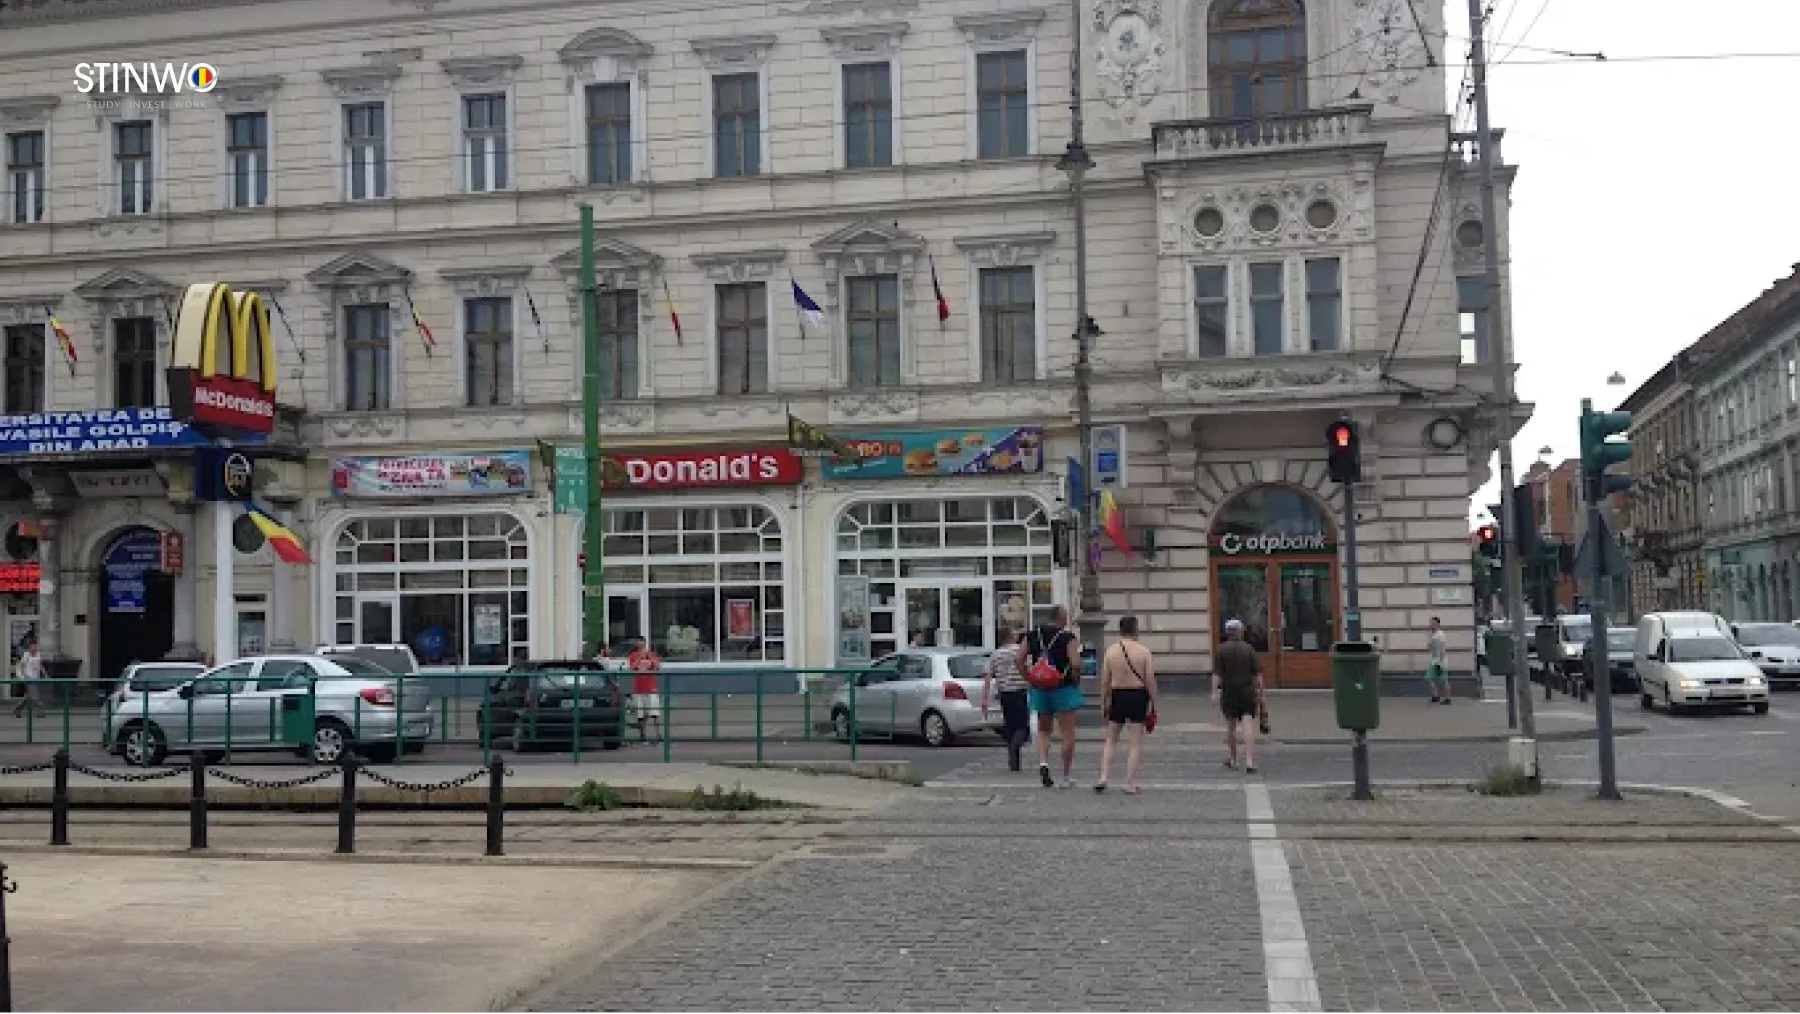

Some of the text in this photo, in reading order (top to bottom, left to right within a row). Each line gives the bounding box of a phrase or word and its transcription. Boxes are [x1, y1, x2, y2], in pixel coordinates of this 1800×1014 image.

[138, 408, 173, 420] DE
[29, 437, 149, 454] DIN ARAD
[626, 453, 780, 483] Donald's
